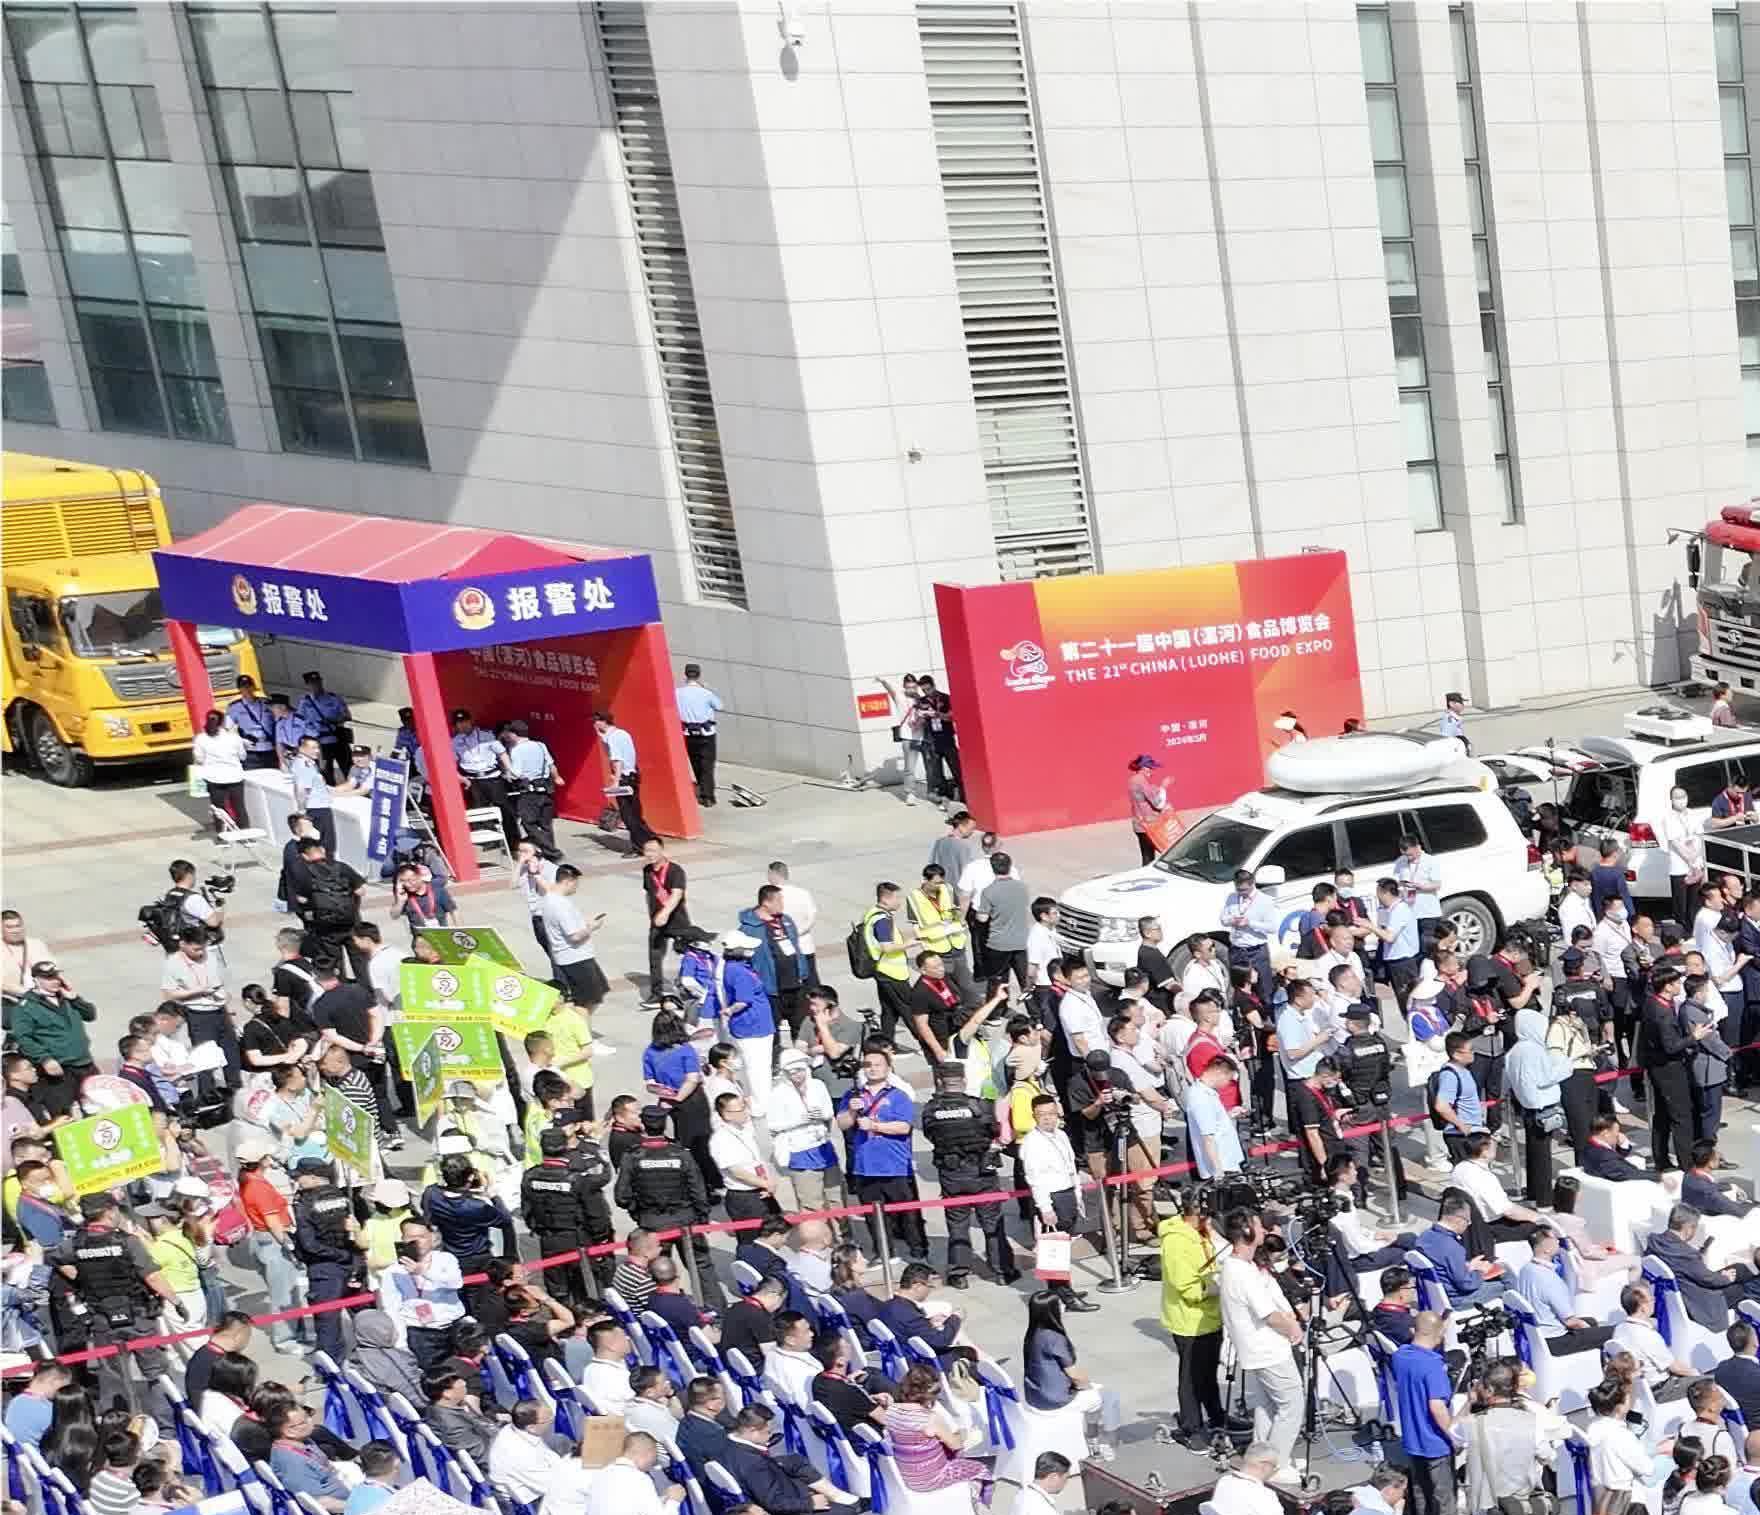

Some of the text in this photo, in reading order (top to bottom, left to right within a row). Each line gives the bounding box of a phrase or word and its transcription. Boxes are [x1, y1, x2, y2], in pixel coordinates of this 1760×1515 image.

[262, 581, 329, 623] 报警处
[506, 576, 616, 623] 报警处
[1064, 667, 1097, 683] THE
[1129, 658, 1179, 676] CHINA
[1249, 643, 1292, 661] FOOD
[1295, 637, 1334, 656] EXPO
